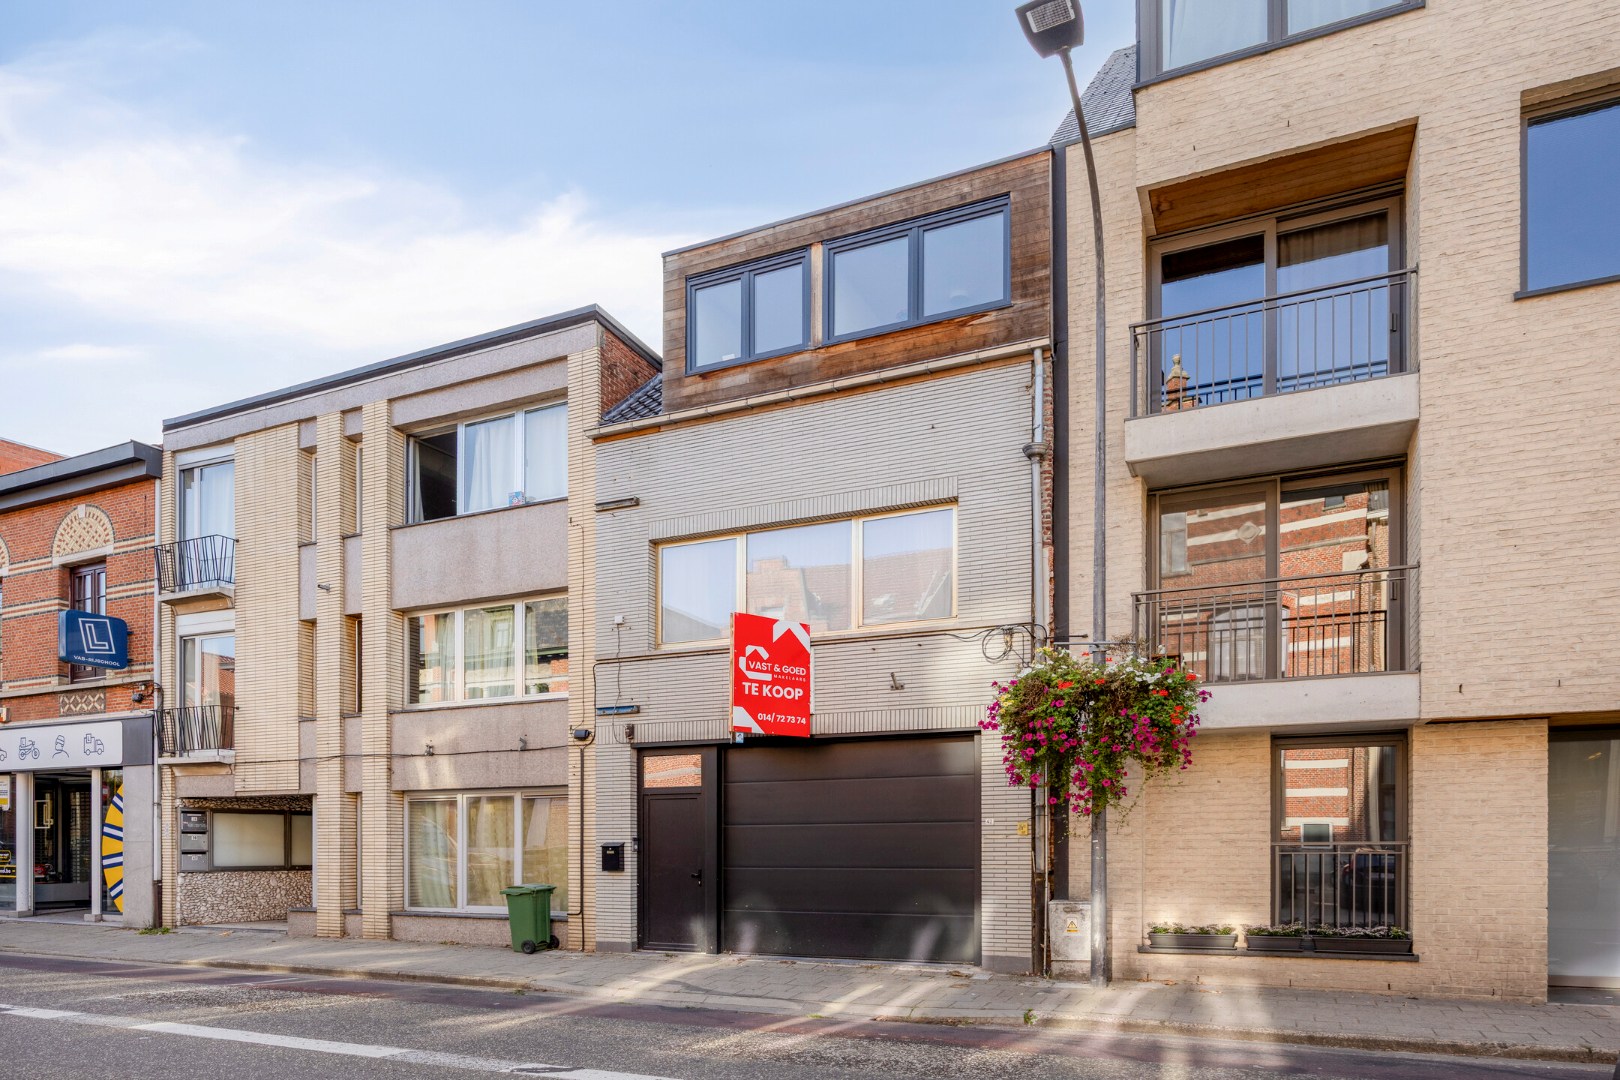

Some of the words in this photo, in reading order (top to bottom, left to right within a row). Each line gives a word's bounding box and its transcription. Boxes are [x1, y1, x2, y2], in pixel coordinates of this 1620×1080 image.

[86, 624, 109, 649] L
[73, 655, 120, 667] VAB-RIJSCHOOL
[748, 660, 772, 671] VAST
[774, 664, 781, 672] &
[782, 665, 806, 675] GOED
[773, 674, 806, 682] MAKELAARS
[742, 682, 759, 695] TE
[762, 684, 803, 700] KOOP
